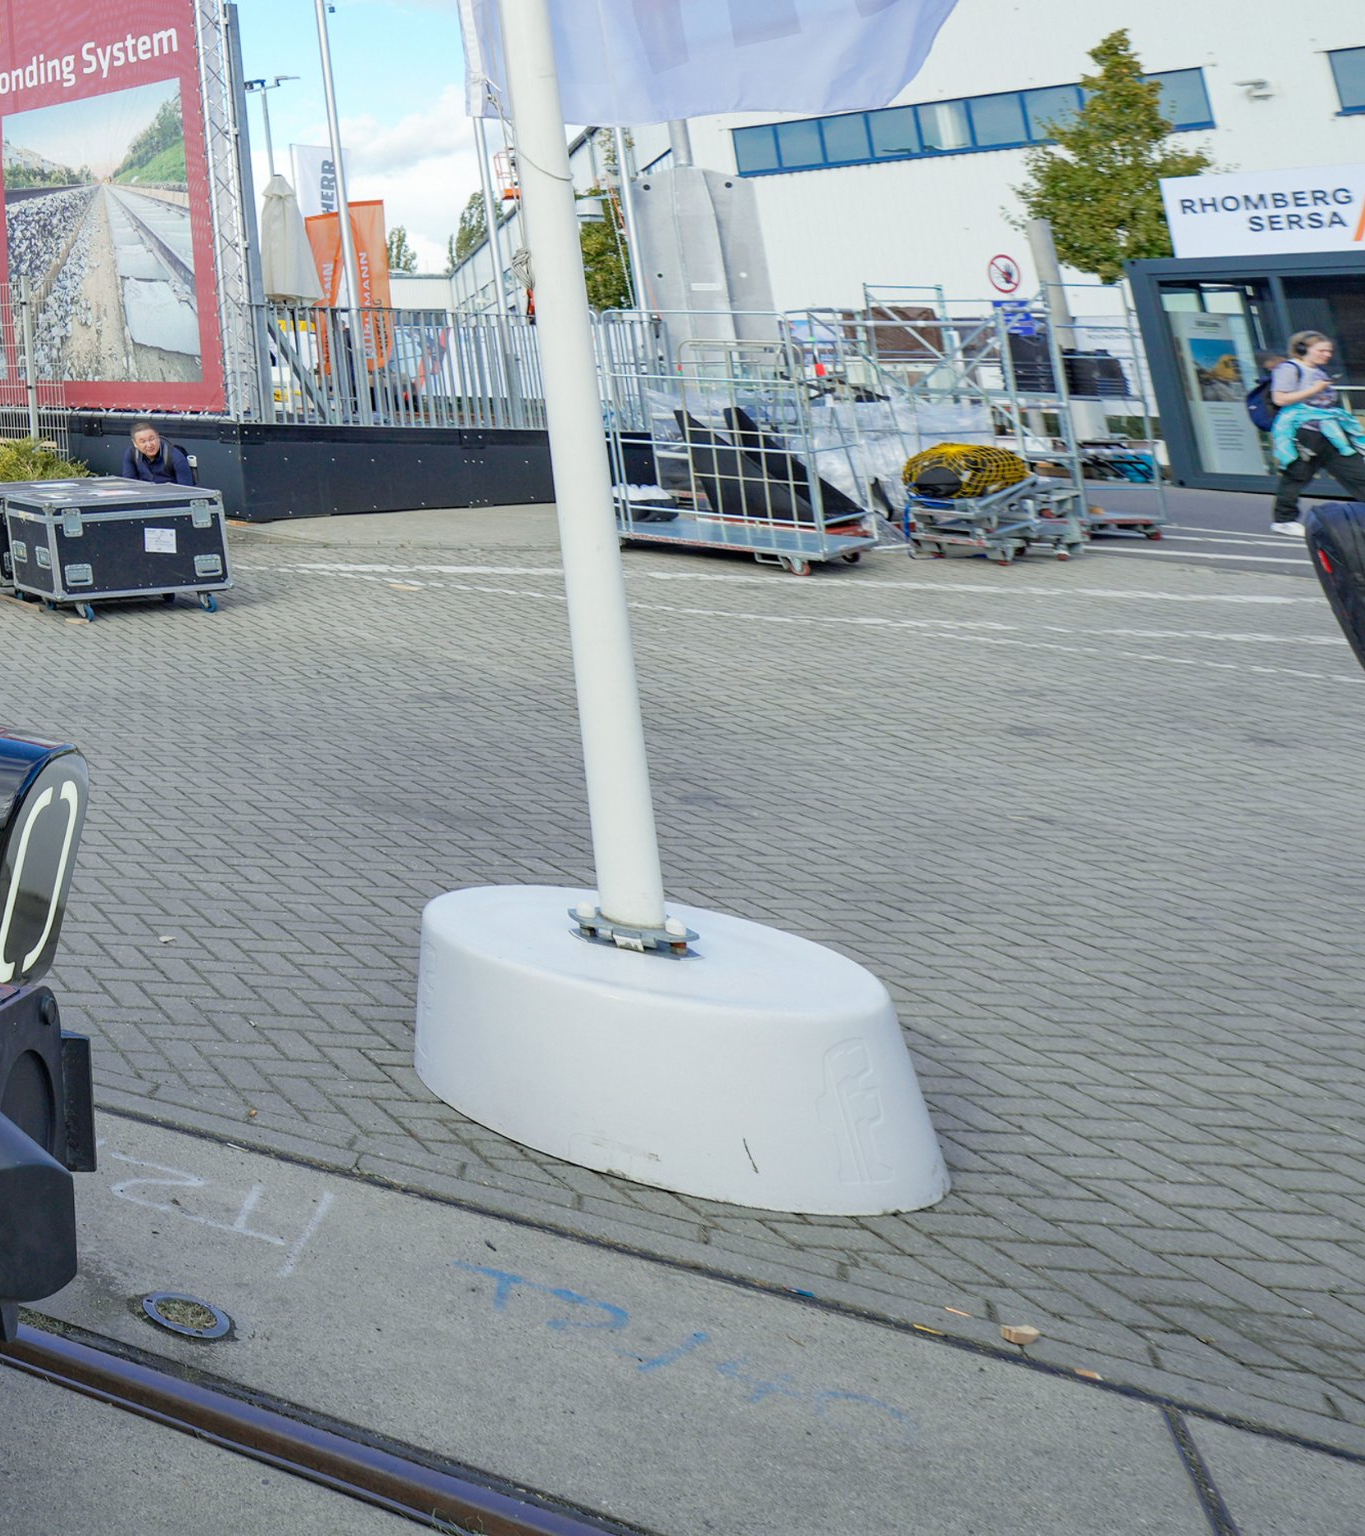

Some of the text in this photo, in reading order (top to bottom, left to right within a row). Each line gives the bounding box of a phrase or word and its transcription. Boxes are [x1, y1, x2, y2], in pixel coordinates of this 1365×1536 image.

[81, 26, 179, 79] System
[1180, 187, 1354, 215] RHOMBERG
[1249, 211, 1348, 232] SERSA
